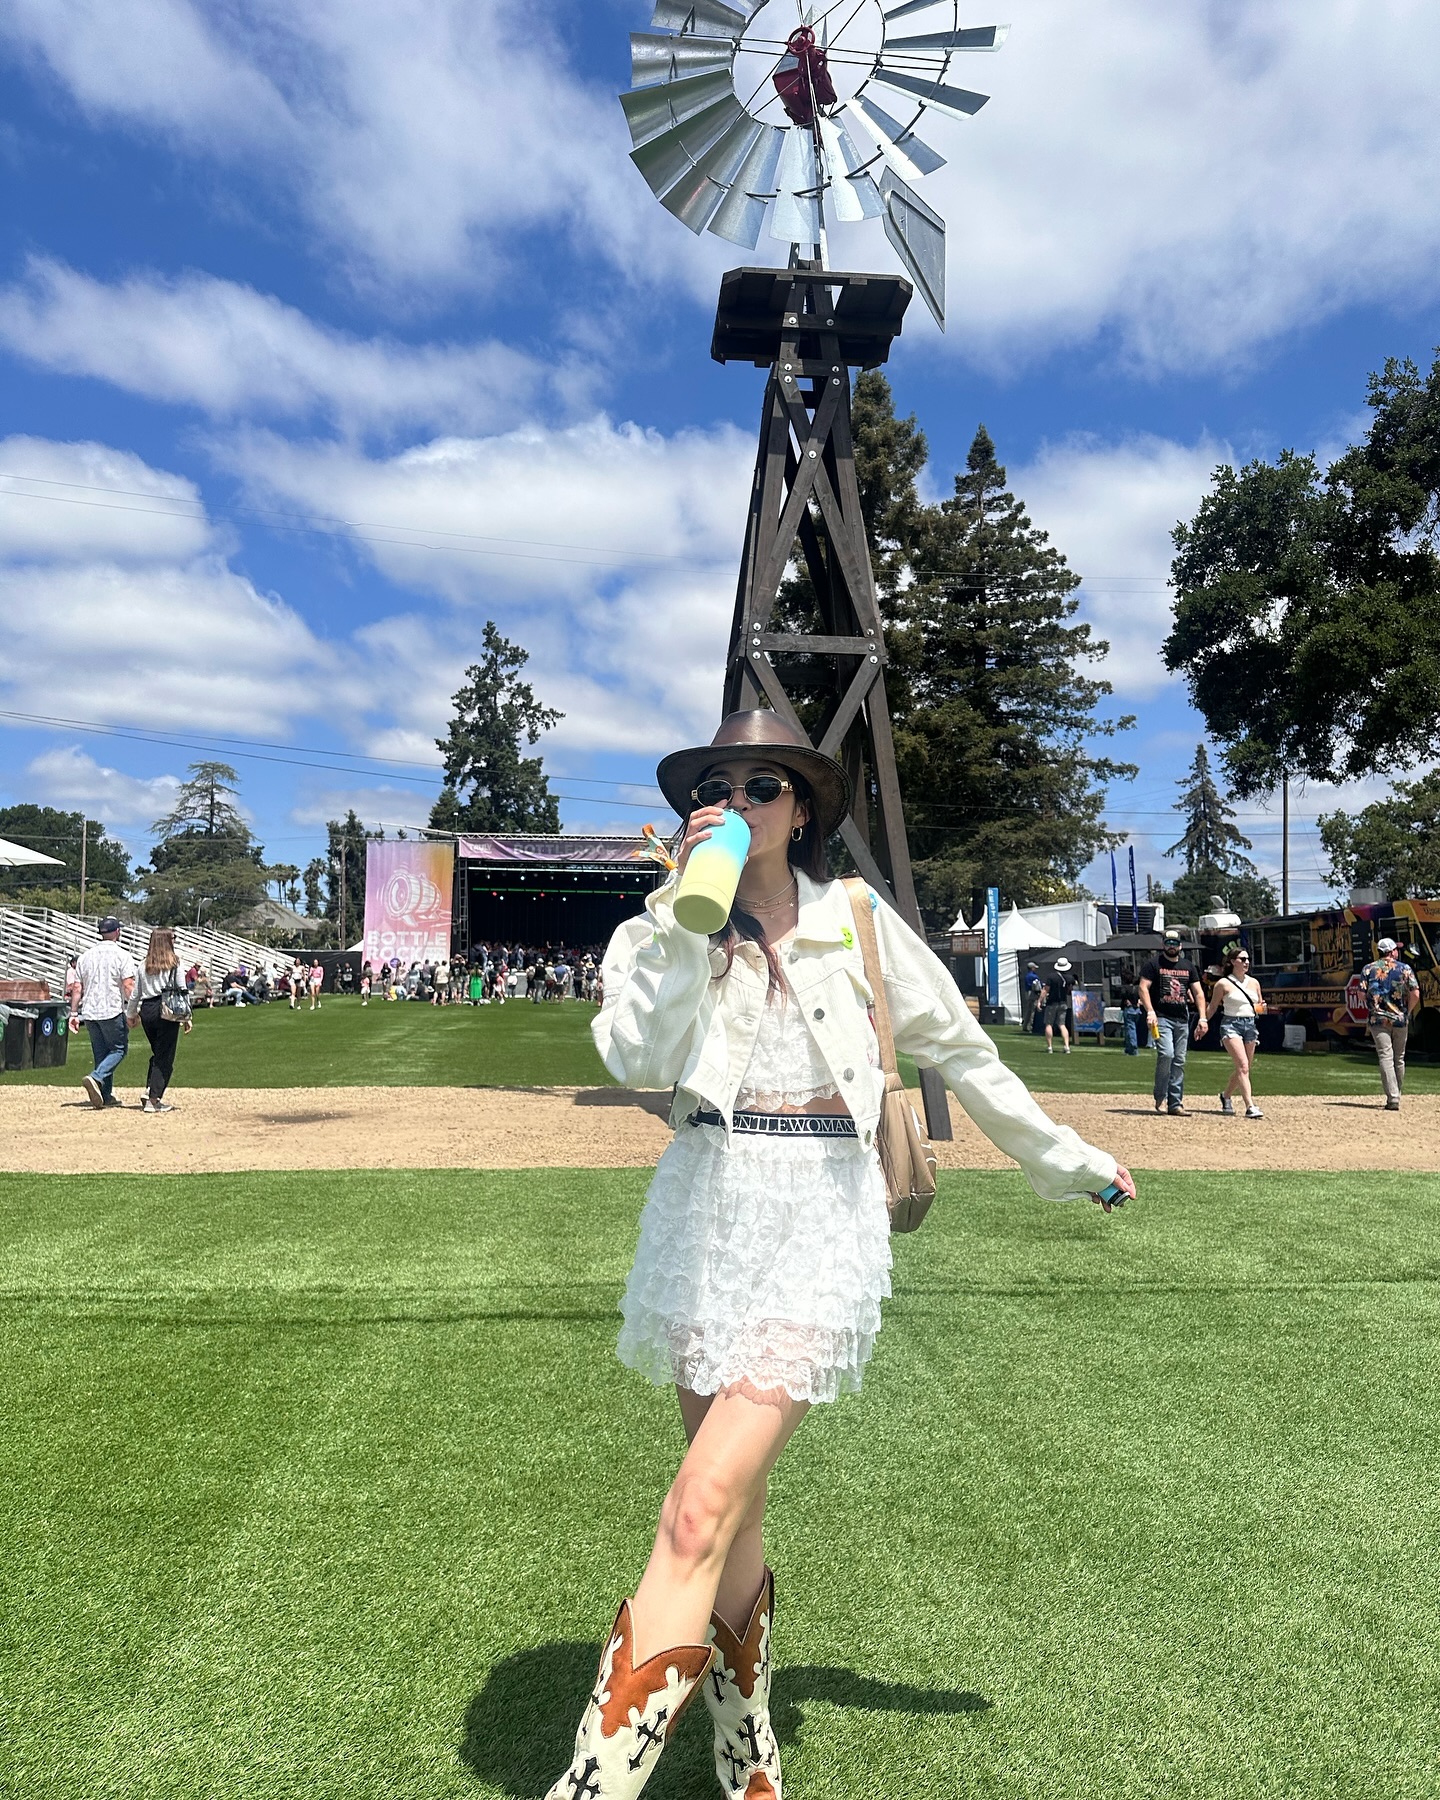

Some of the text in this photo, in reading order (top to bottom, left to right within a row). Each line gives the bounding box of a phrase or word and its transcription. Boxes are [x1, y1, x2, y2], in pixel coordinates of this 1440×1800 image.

[988, 889, 997, 952] RESTROOMS
[367, 931, 447, 945] BOTTLE
[366, 946, 423, 960] ROCK
